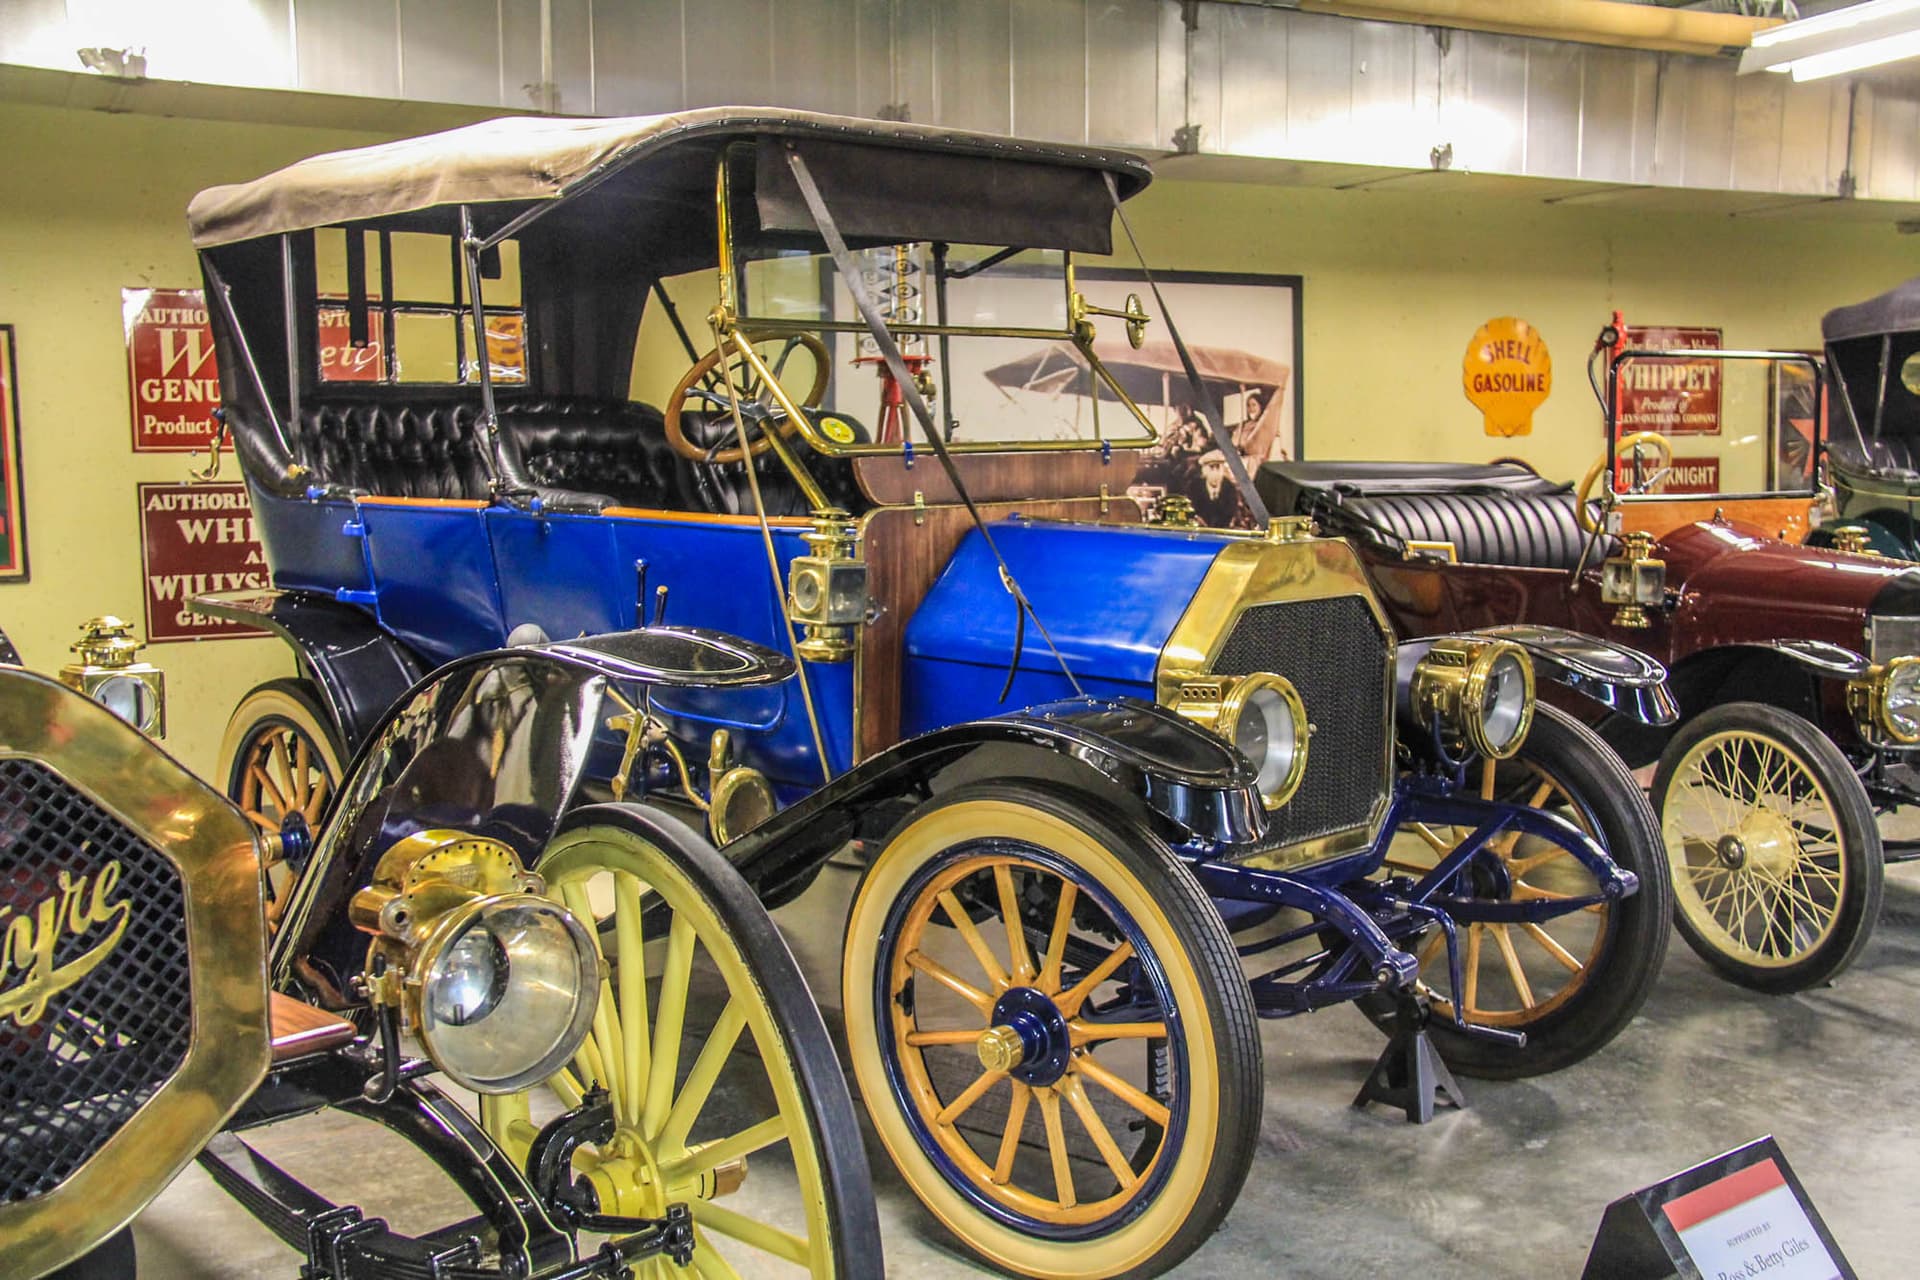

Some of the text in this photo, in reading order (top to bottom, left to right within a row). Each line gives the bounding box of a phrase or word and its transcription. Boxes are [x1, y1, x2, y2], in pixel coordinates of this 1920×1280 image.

[137, 308, 209, 325] AUTHO
[1486, 339, 1531, 365] SHELL
[141, 378, 222, 403] GENU
[1473, 373, 1546, 393] GASOLINE
[144, 414, 212, 435] Product
[1743, 1260, 1759, 1278] &
[1754, 1250, 1785, 1272] Betty
[1781, 1237, 1810, 1258] Giles
